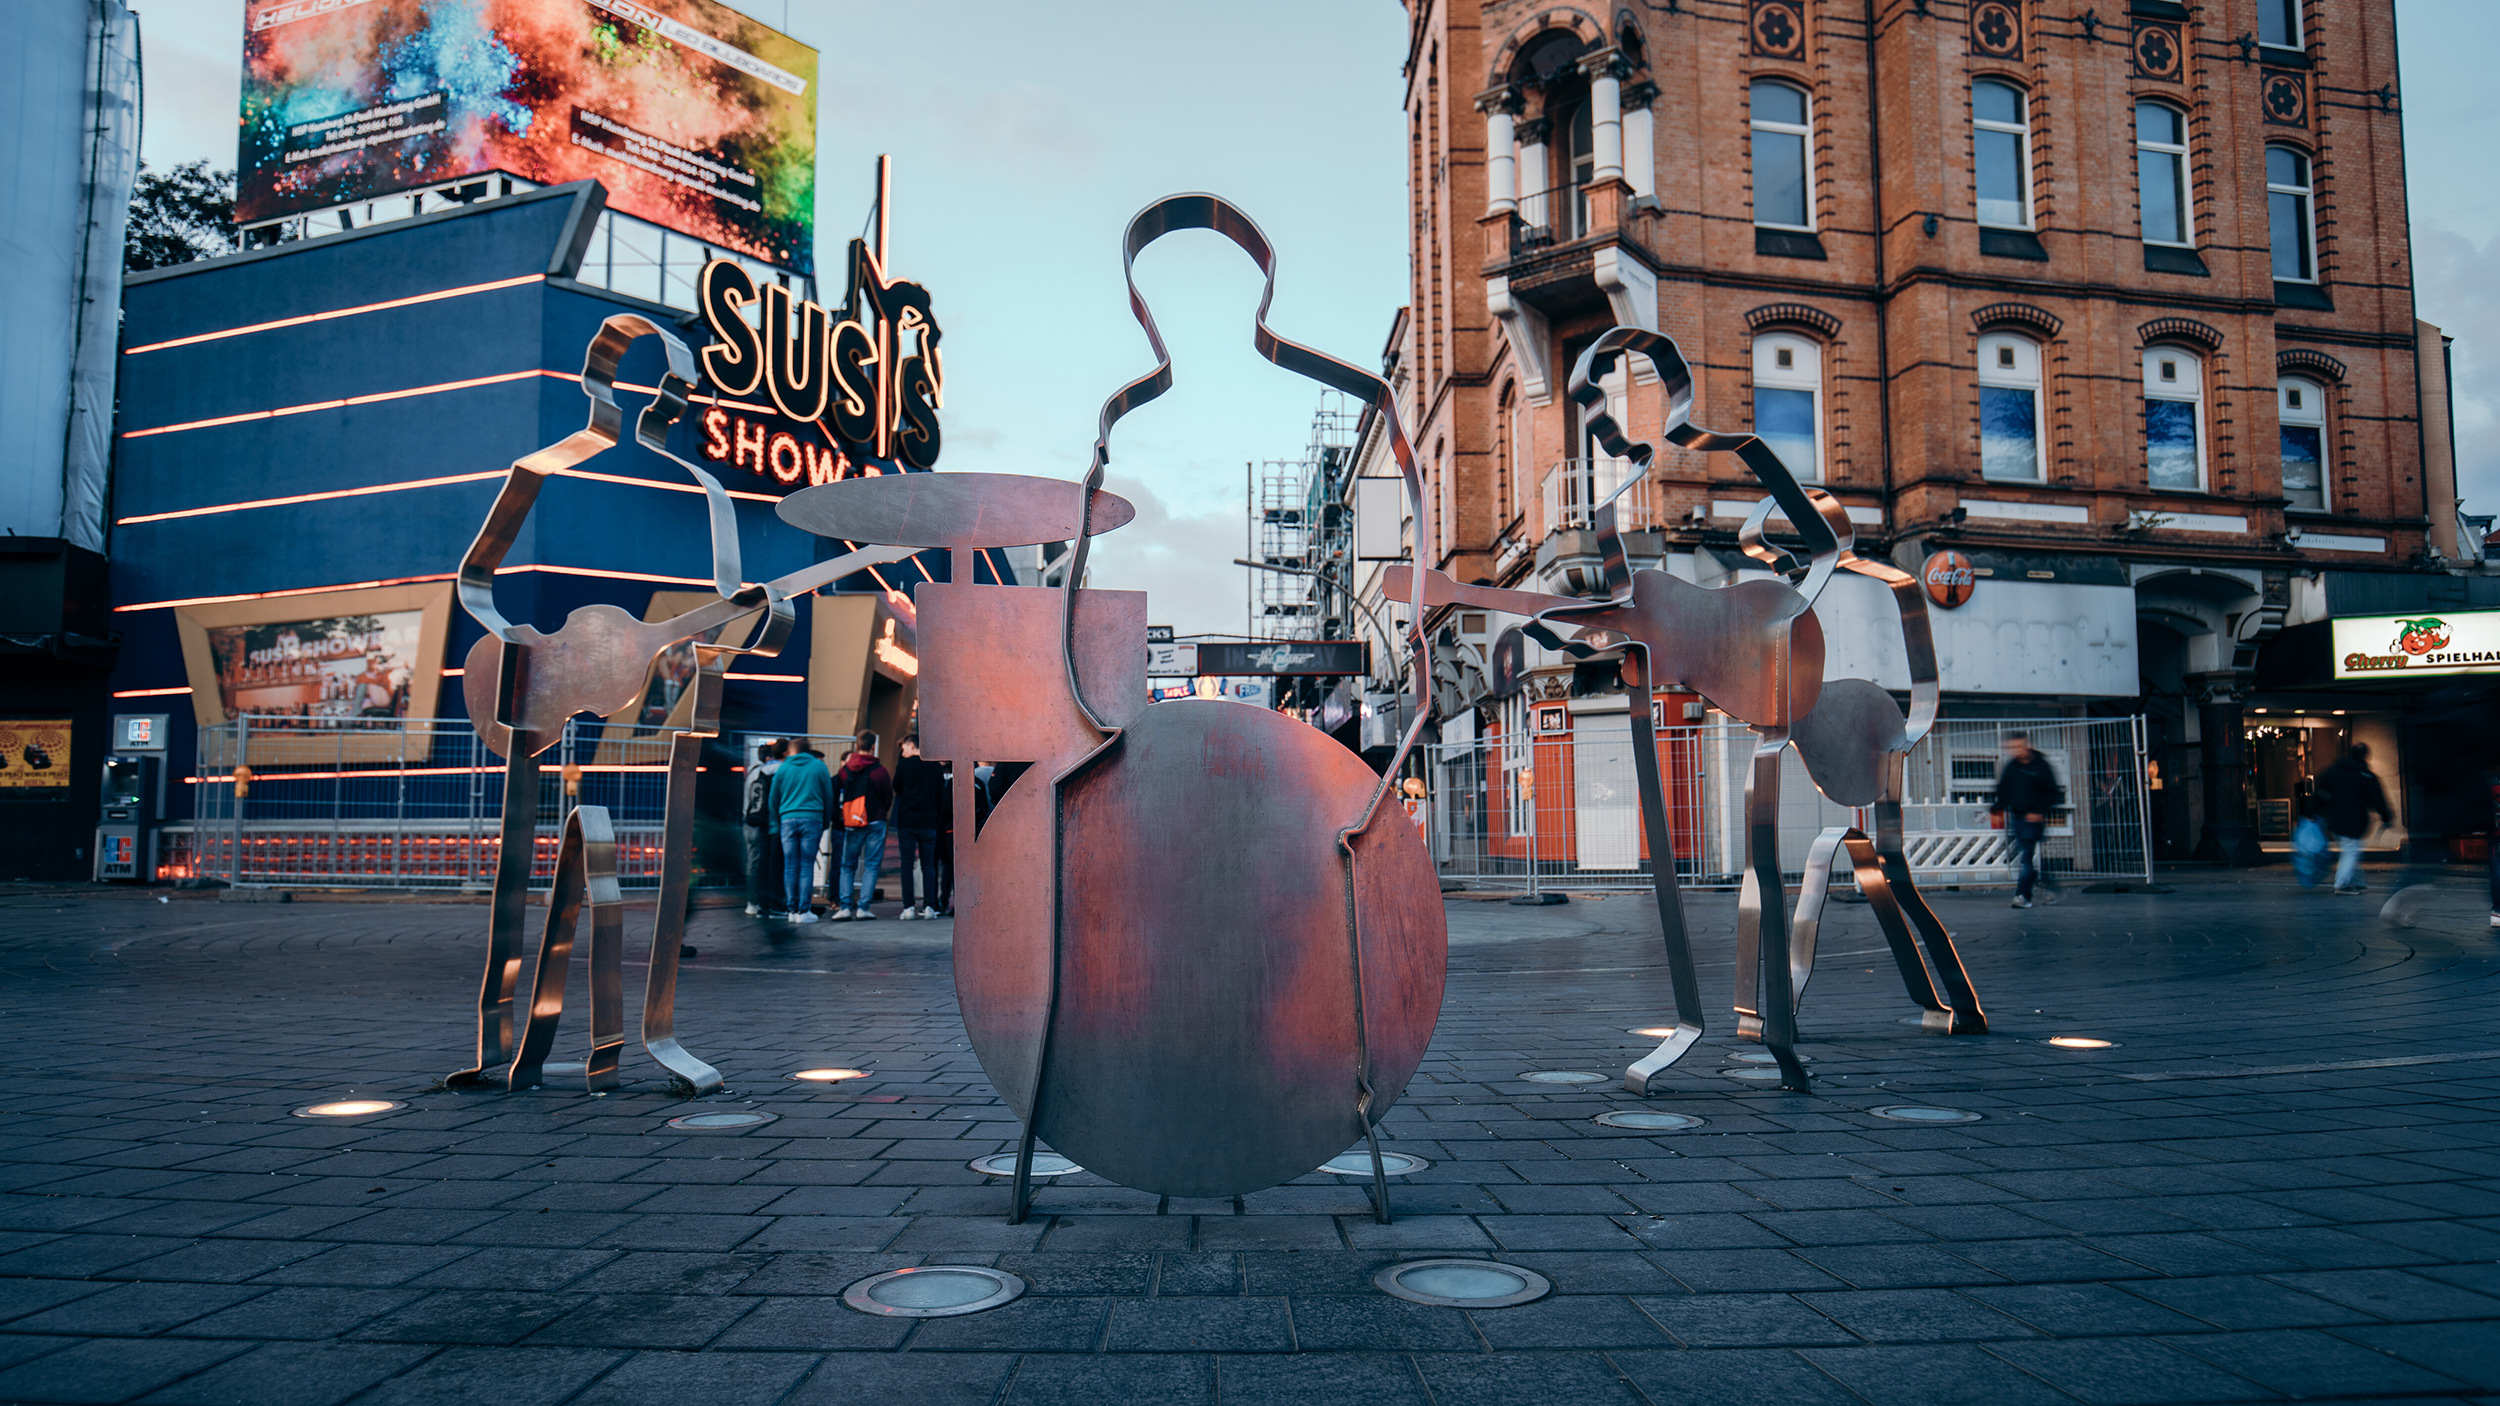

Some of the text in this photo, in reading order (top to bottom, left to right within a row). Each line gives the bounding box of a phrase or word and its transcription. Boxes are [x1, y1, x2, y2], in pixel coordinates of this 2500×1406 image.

[256, 0, 354, 27] HELIO
[307, 118, 344, 134] Hamburg
[373, 101, 415, 118] Marketing
[413, 92, 442, 110] GmbH
[601, 118, 648, 147] Hamburg
[682, 149, 728, 178] Marketing
[727, 167, 756, 187] GmbH
[2344, 653, 2409, 670] Cherry
[104, 864, 132, 874] ATM
